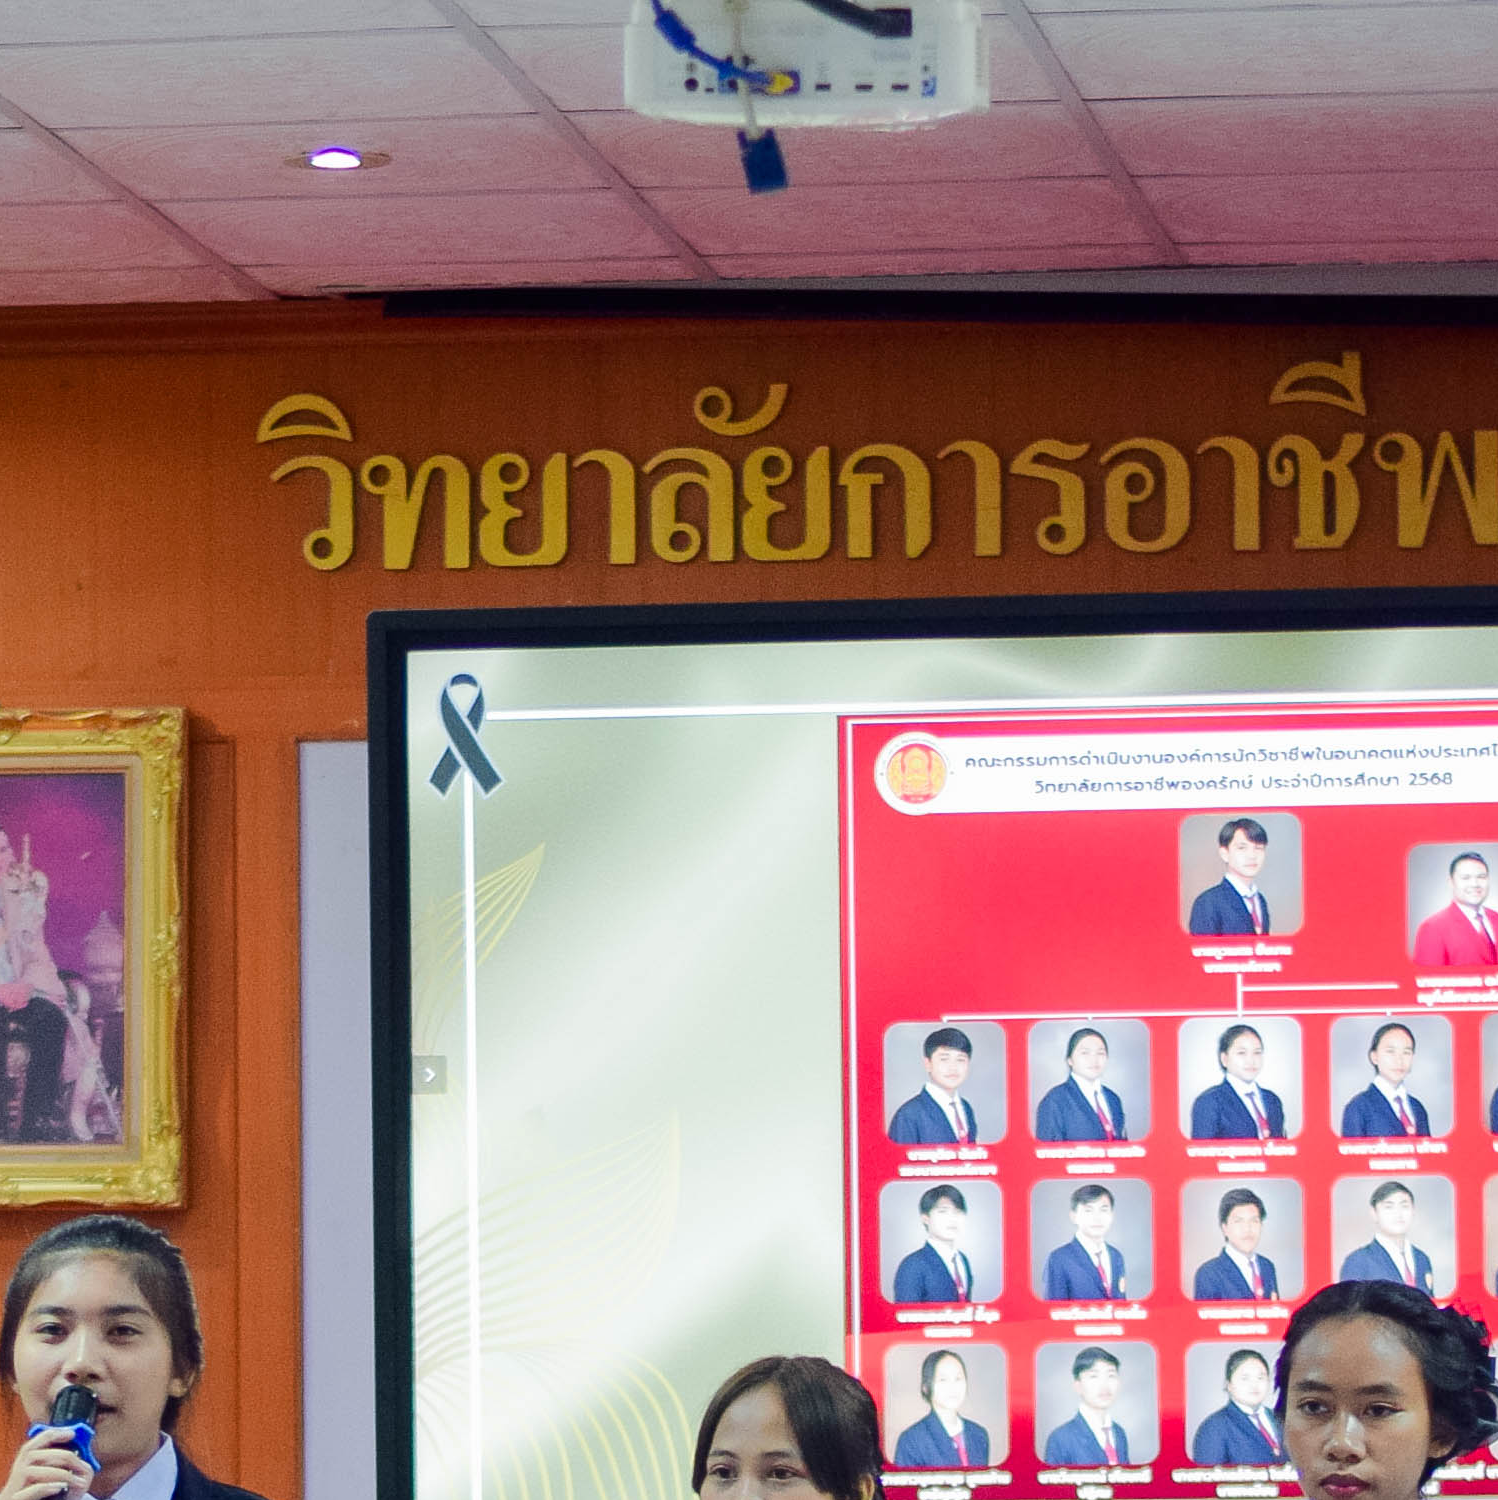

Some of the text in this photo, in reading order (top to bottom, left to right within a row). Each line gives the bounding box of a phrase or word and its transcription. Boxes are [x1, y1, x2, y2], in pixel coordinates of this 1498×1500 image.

[1034, 772, 1453, 794] วิทยาลัยการอาชีพองครักษ์ ประจำปีการศึกษา 2568
